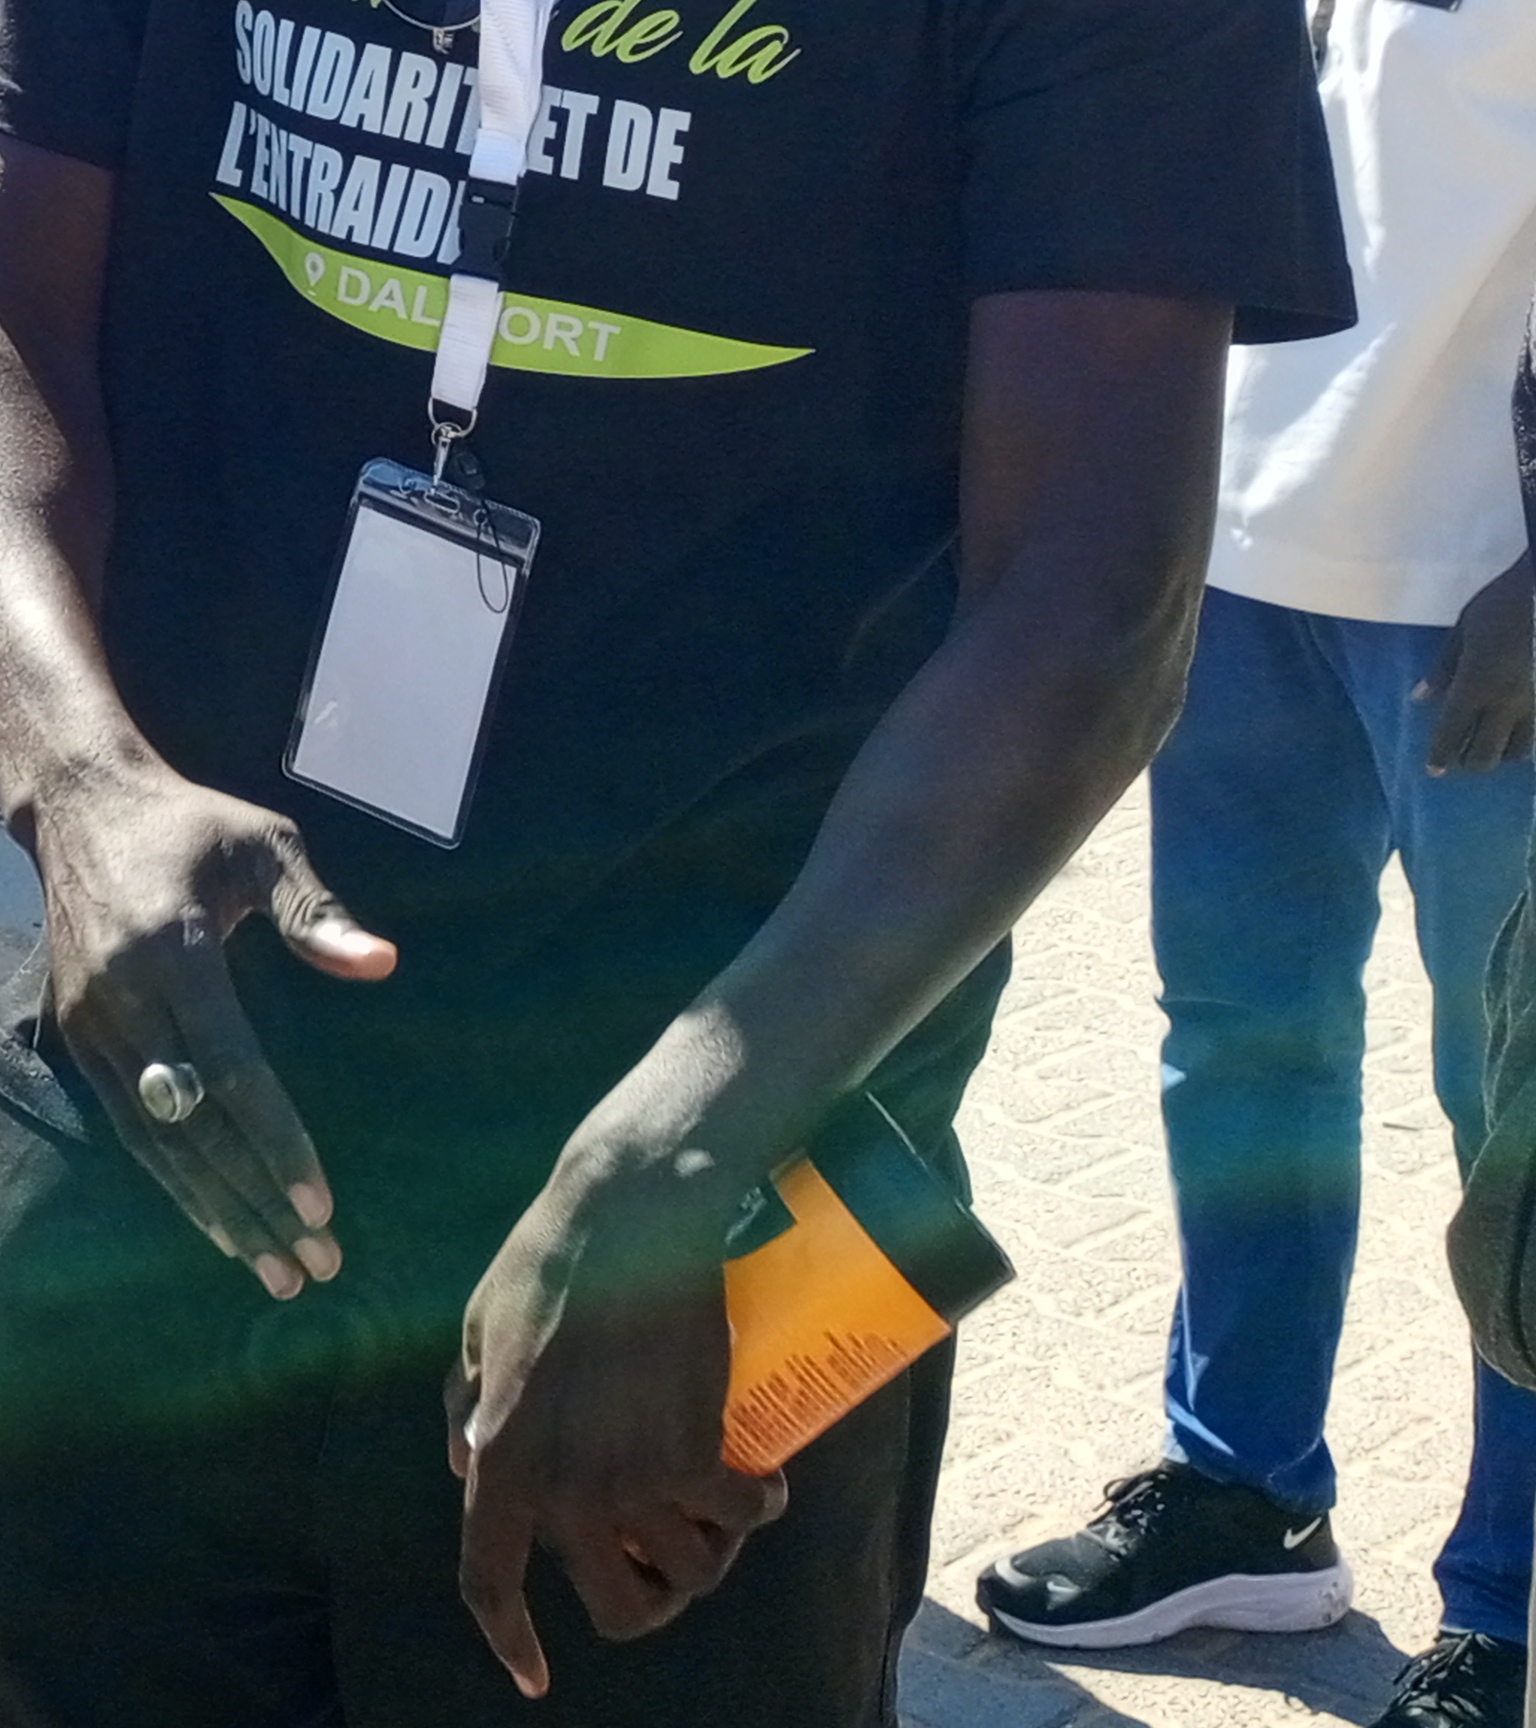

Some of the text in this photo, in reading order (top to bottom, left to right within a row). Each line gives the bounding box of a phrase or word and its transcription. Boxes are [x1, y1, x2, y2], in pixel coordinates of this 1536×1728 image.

[235, 0, 692, 200] SOLIDARIT ET DE
[337, 266, 621, 361] DALORT
